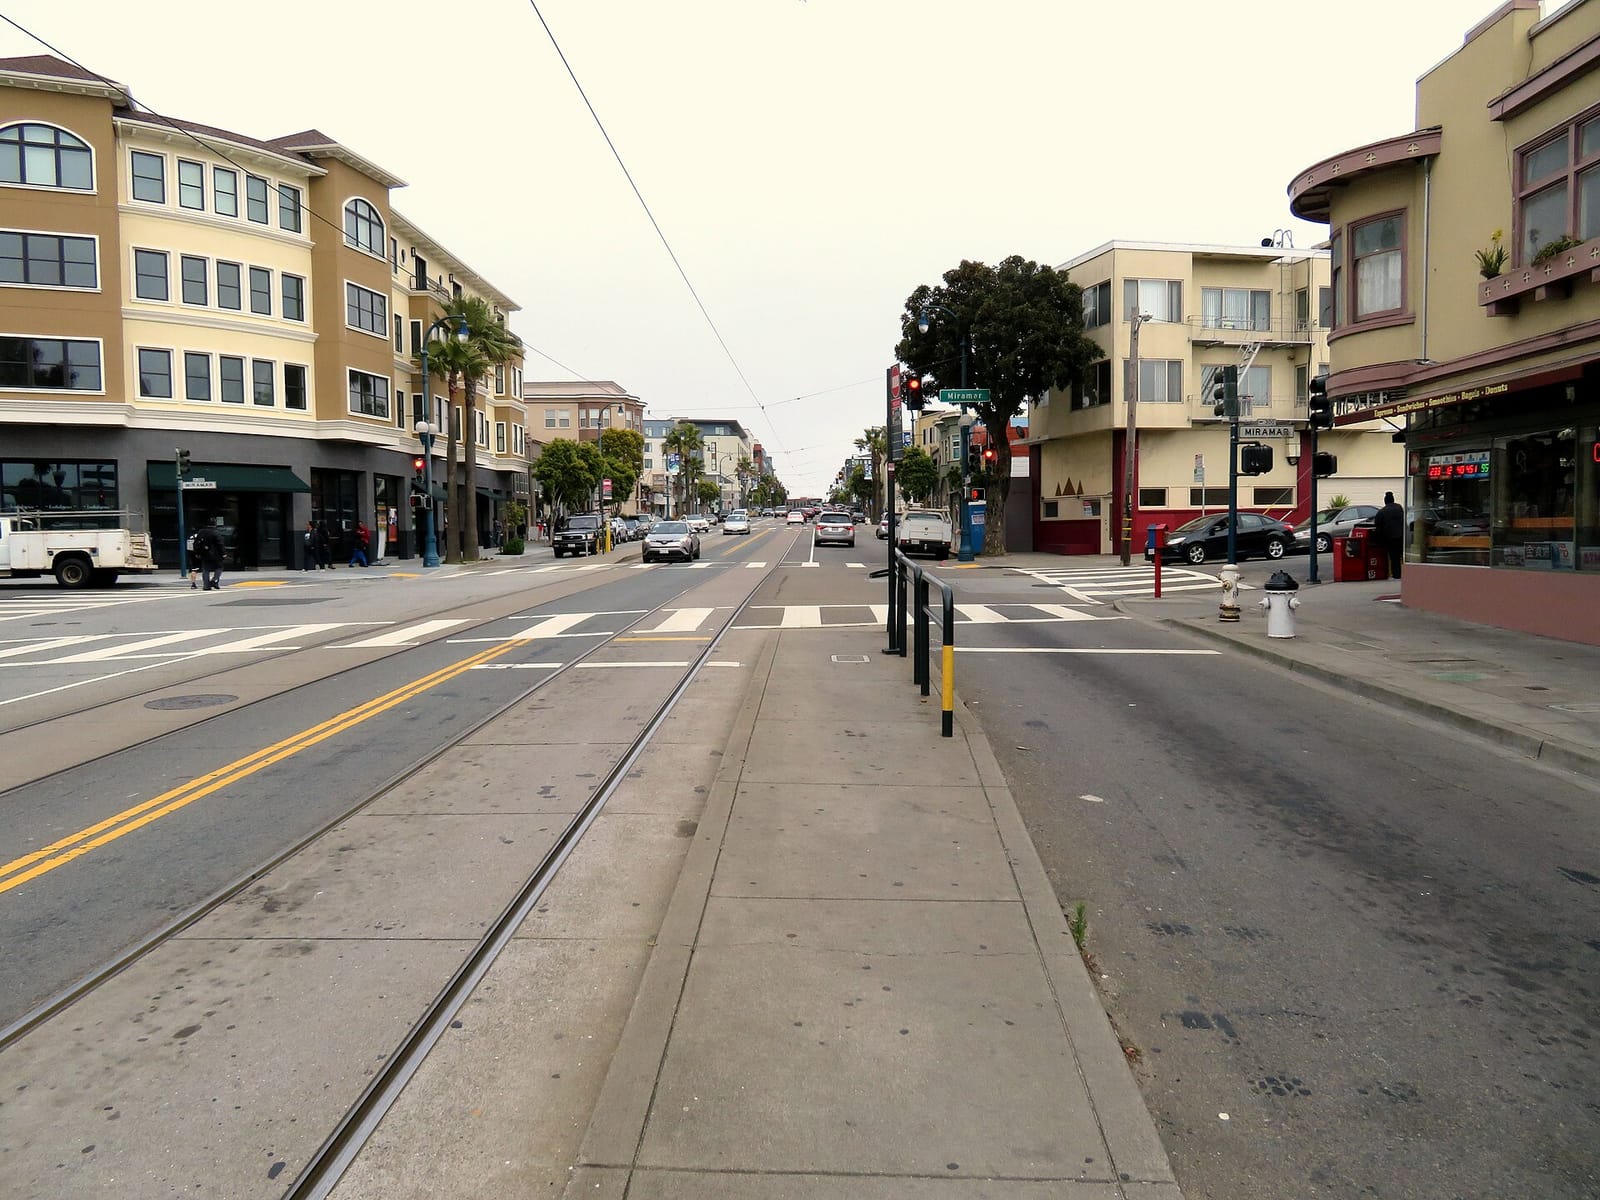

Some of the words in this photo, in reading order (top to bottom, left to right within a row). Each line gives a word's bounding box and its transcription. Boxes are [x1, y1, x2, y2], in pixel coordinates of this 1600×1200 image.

[1484, 383, 1508, 395] Donuts
[947, 392, 982, 400] Miramar
[1244, 428, 1290, 437] MIRAMAR
